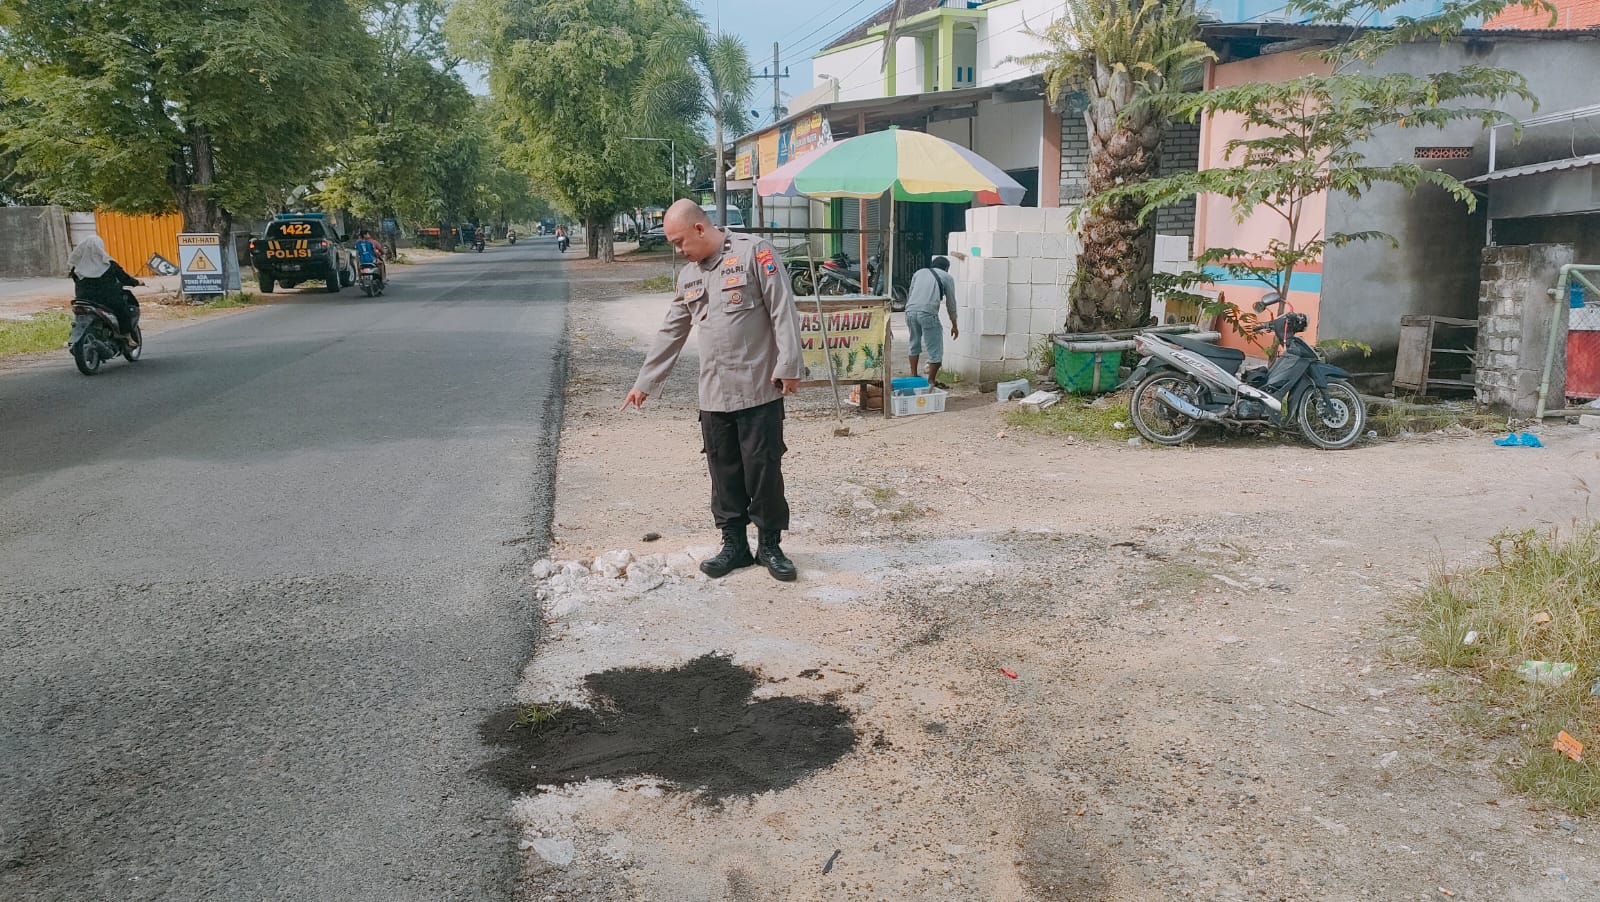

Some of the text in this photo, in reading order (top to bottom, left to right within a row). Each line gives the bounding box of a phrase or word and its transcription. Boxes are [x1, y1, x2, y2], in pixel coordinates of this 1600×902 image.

[280, 224, 312, 235] 1422
[266, 249, 312, 258] POLISI
[720, 264, 744, 276] POLRI
[797, 311, 873, 332] AS MADU
